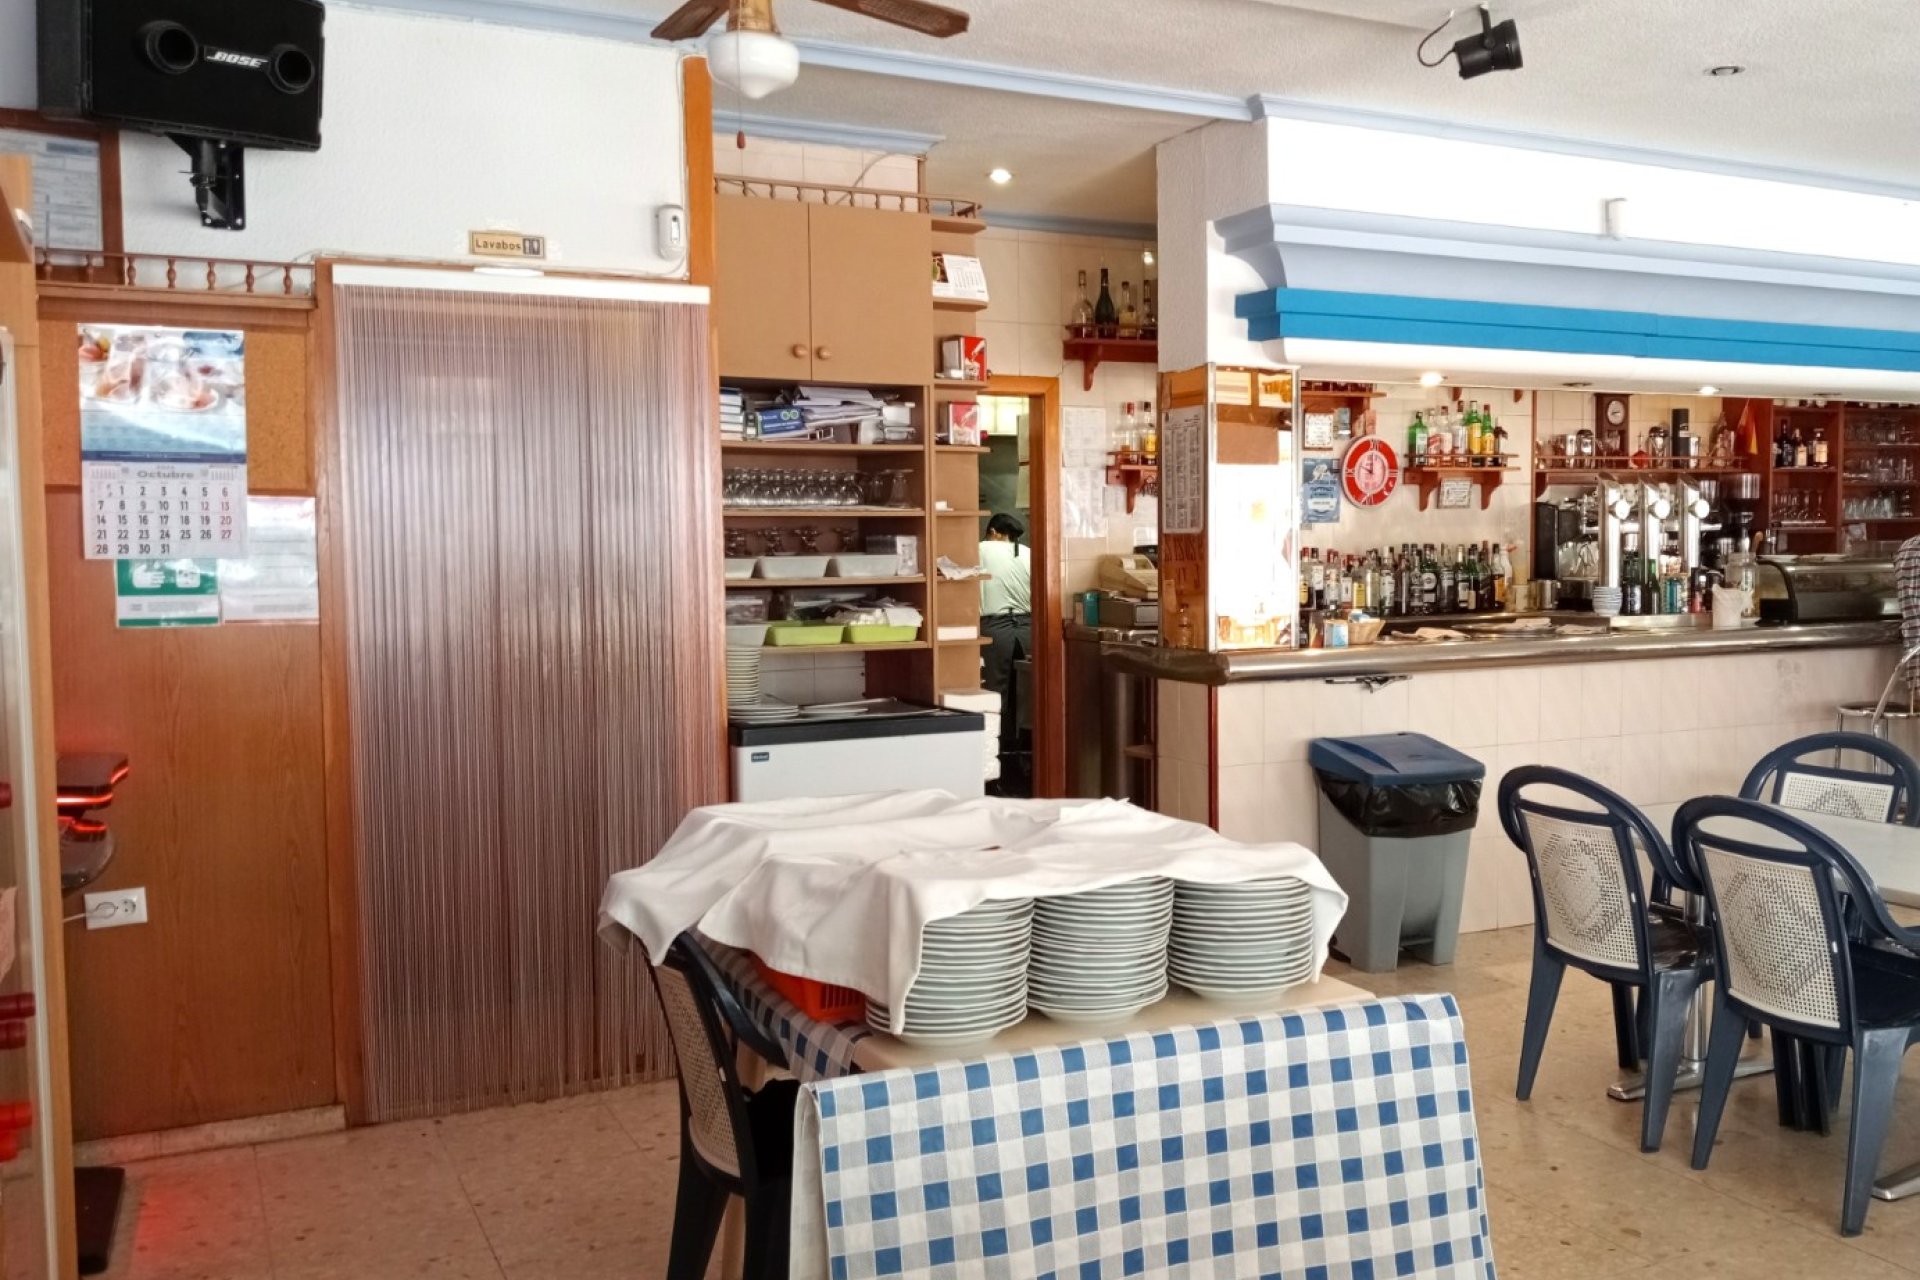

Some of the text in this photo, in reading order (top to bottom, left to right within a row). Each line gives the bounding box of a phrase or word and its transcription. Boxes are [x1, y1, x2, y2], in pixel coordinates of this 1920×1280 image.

[206, 51, 268, 68] BOSE
[475, 237, 521, 250] Lavabos
[137, 470, 195, 479] Octubre
[120, 486, 228, 497] 1 2 3 4 5 6
[98, 501, 230, 511] 7 8 9 10 11 12 13
[97, 515, 232, 526] 14 15 16 17 18 19 20
[97, 530, 232, 540] 21 22 23 24 25 26 27
[96, 545, 170, 555] 28 29 30 31
